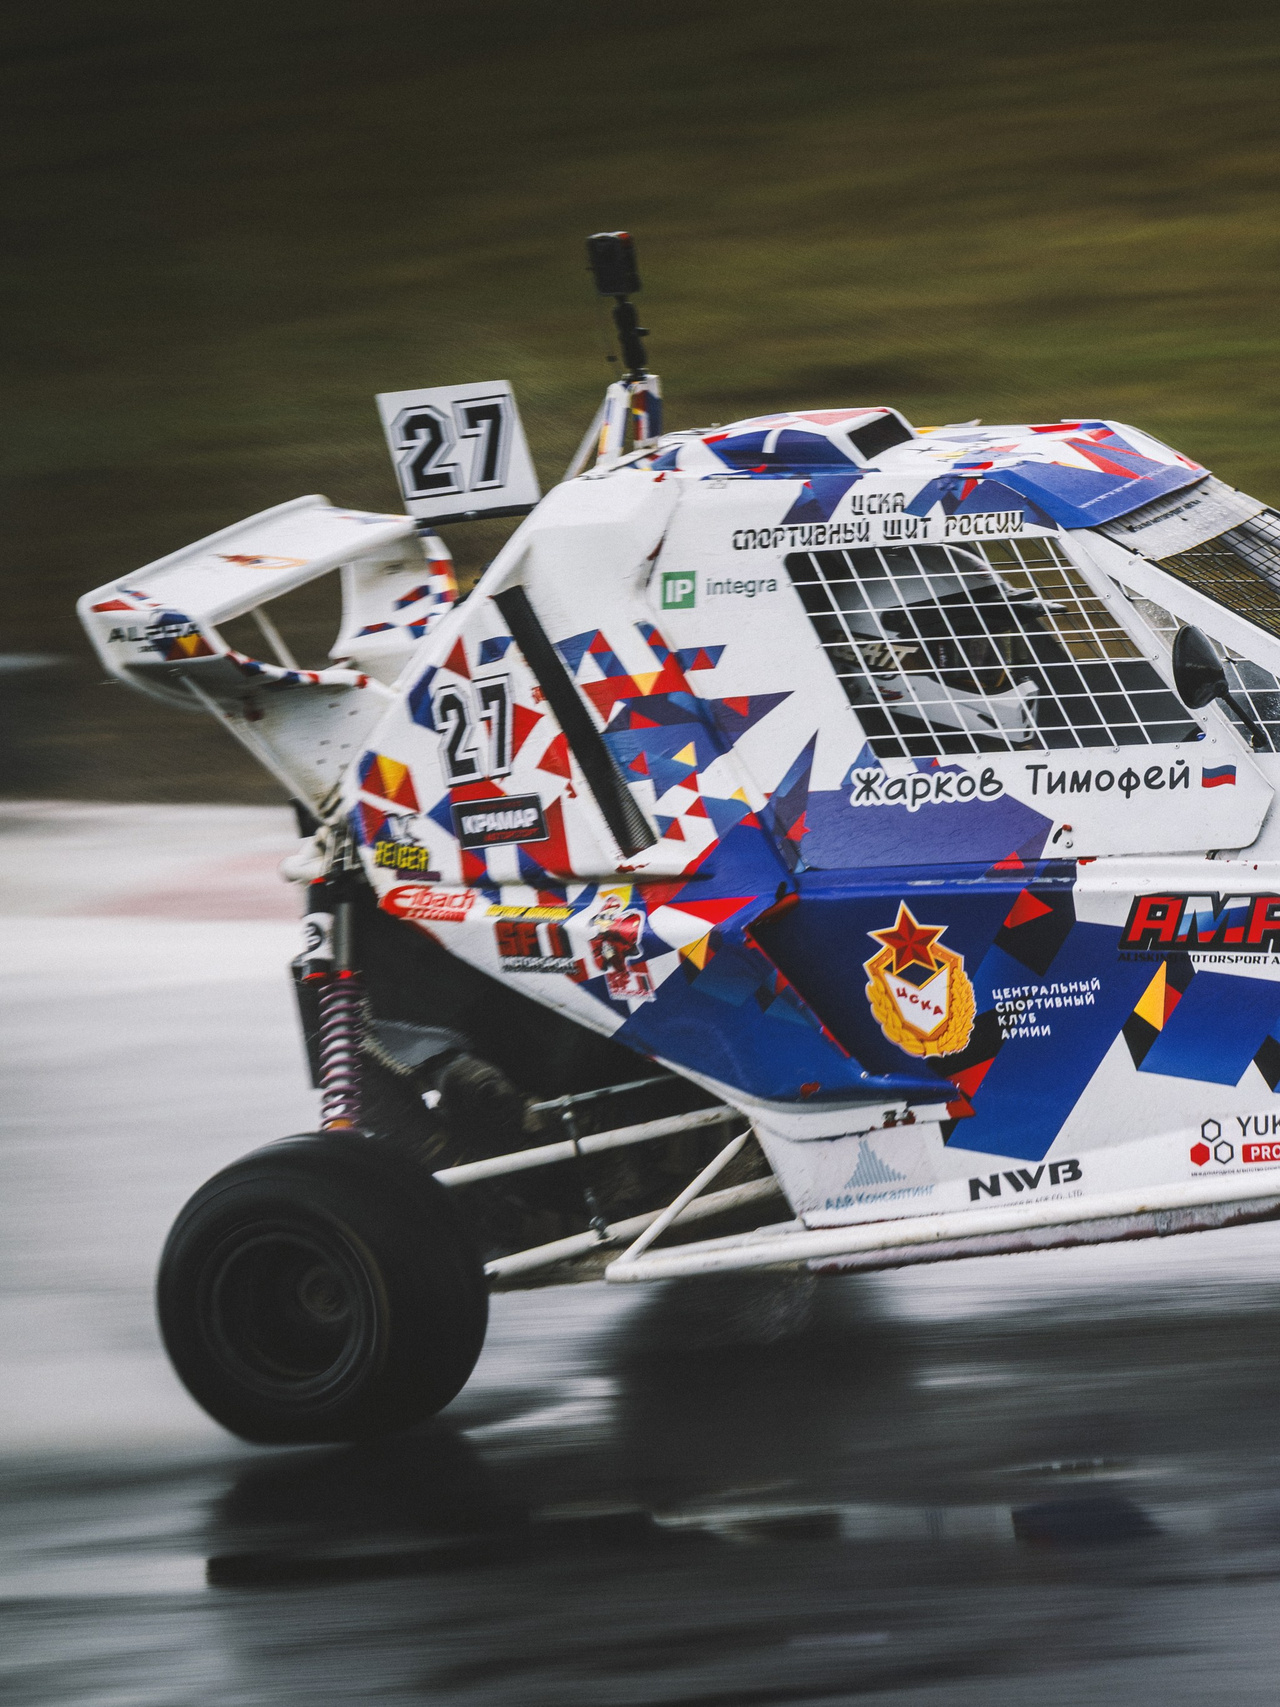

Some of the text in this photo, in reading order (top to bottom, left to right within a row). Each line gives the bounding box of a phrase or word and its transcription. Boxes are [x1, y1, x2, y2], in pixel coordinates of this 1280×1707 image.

[390, 393, 510, 501] 27
[851, 492, 906, 516] ЦСКА
[732, 517, 870, 551] СПОРТИВНЫЙ
[944, 511, 1025, 537] РОССИИ
[664, 577, 694, 604] IP
[706, 575, 777, 595] integra
[433, 672, 510, 787] 27
[854, 758, 1190, 807] Жарков Тимофей
[461, 808, 539, 835] КРАМАР
[895, 987, 944, 1017] ЦСКА
[992, 977, 1100, 1000] ЦЕНТРАЛЬНЫЙ
[995, 993, 1095, 1013] СПОРТИВНЫЙ
[998, 1014, 1036, 1027] КЛУБ
[1001, 1025, 1051, 1040] АРМИИ
[968, 1158, 1083, 1202] NWB
